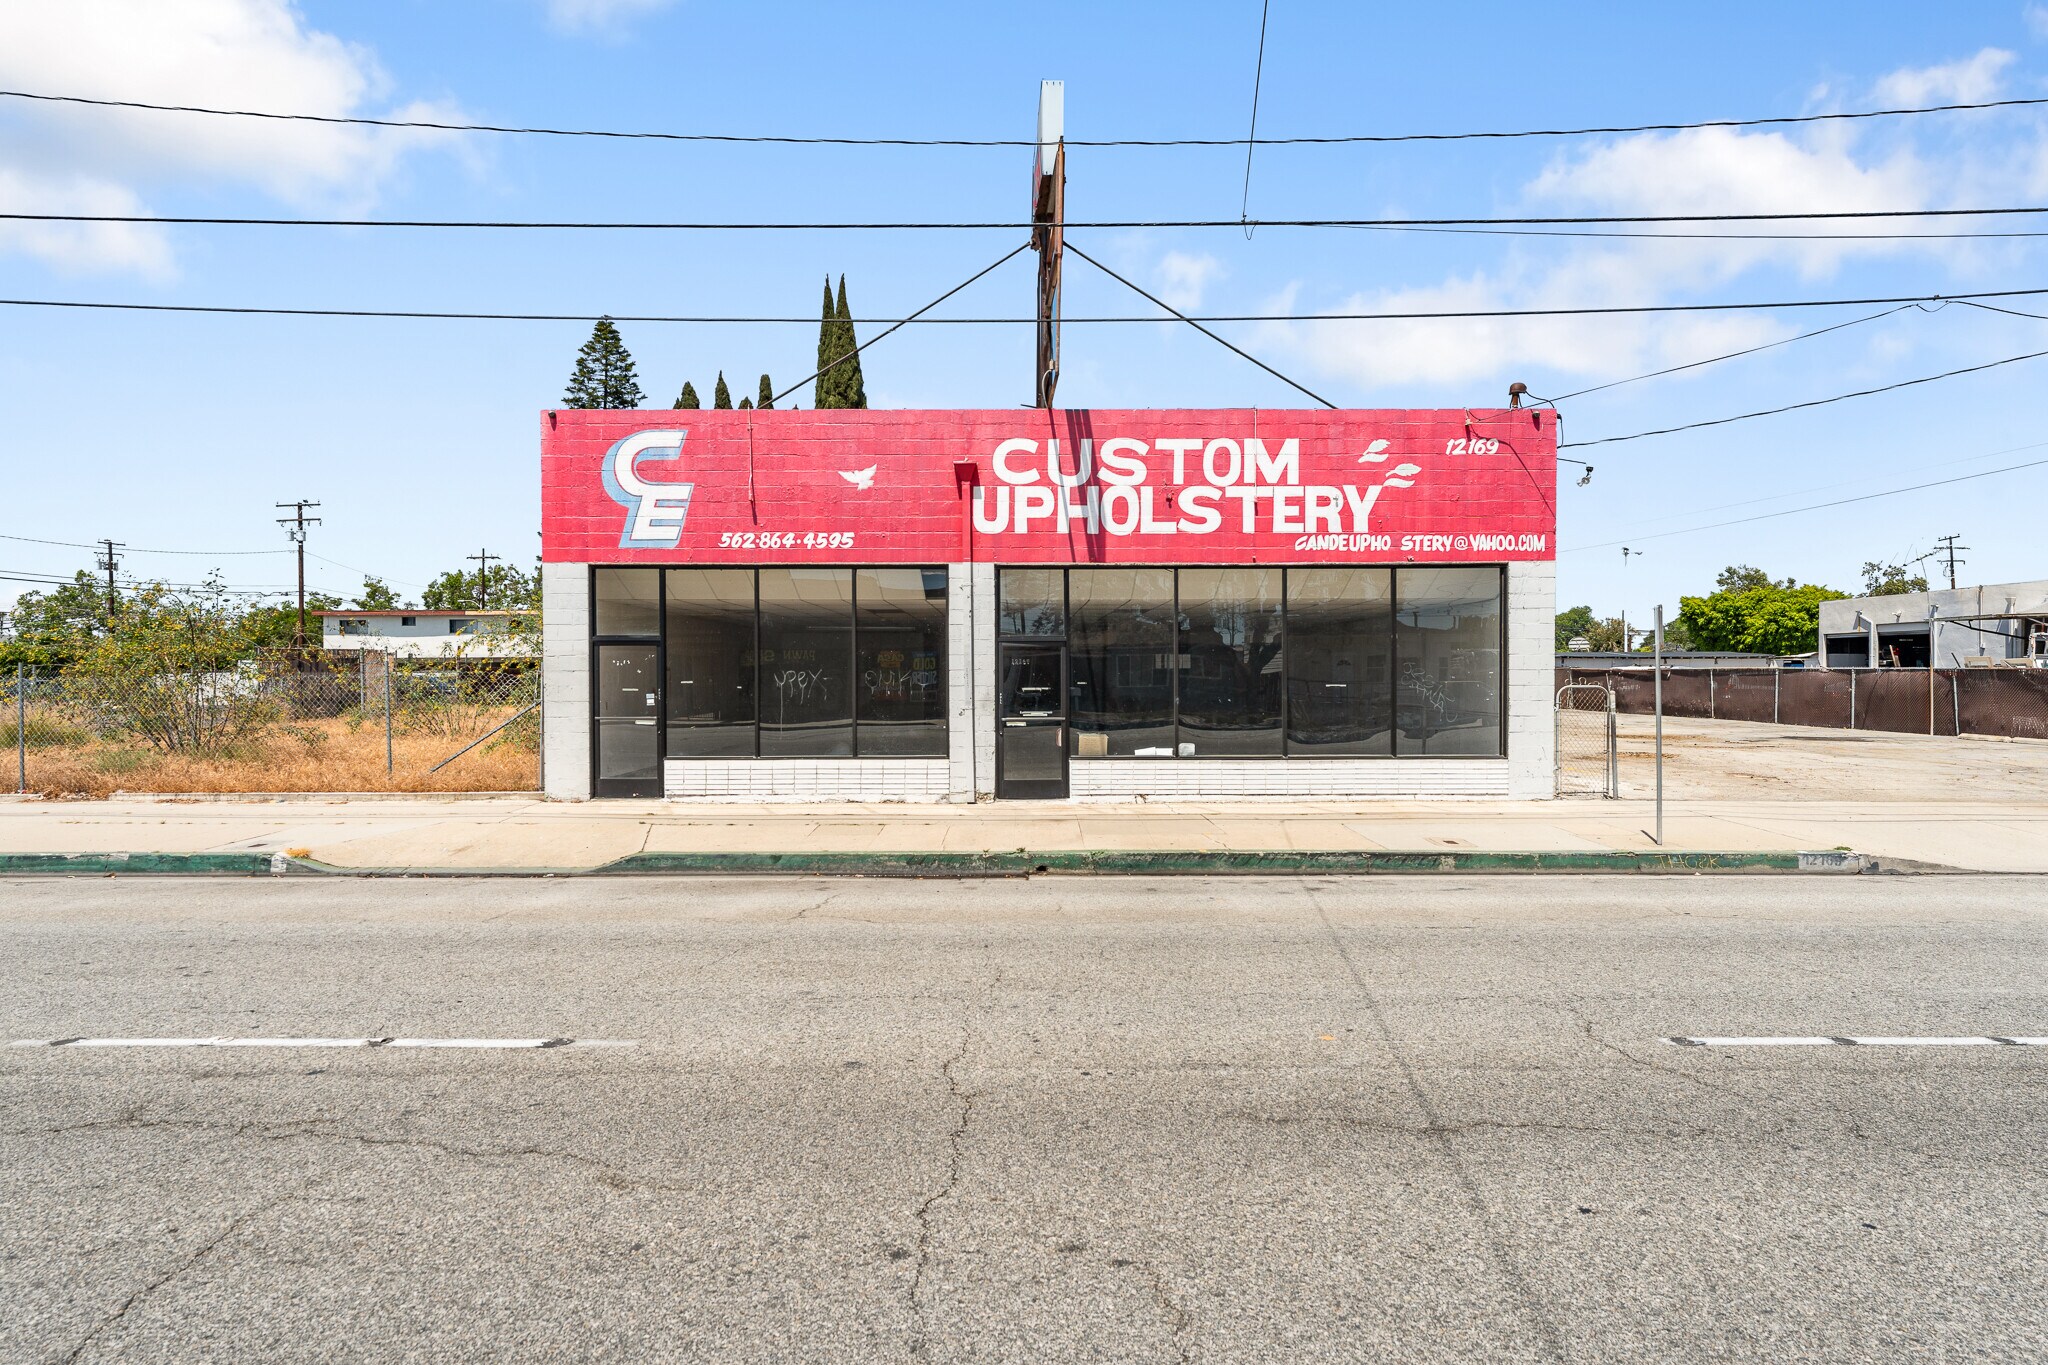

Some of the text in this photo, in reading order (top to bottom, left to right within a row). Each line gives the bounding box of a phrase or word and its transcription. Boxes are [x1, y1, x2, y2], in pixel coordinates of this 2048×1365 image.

[992, 438, 1299, 486] CUSTOM
[1445, 438, 1499, 455] 12169
[972, 485, 1383, 536] UPHOLSTERY
